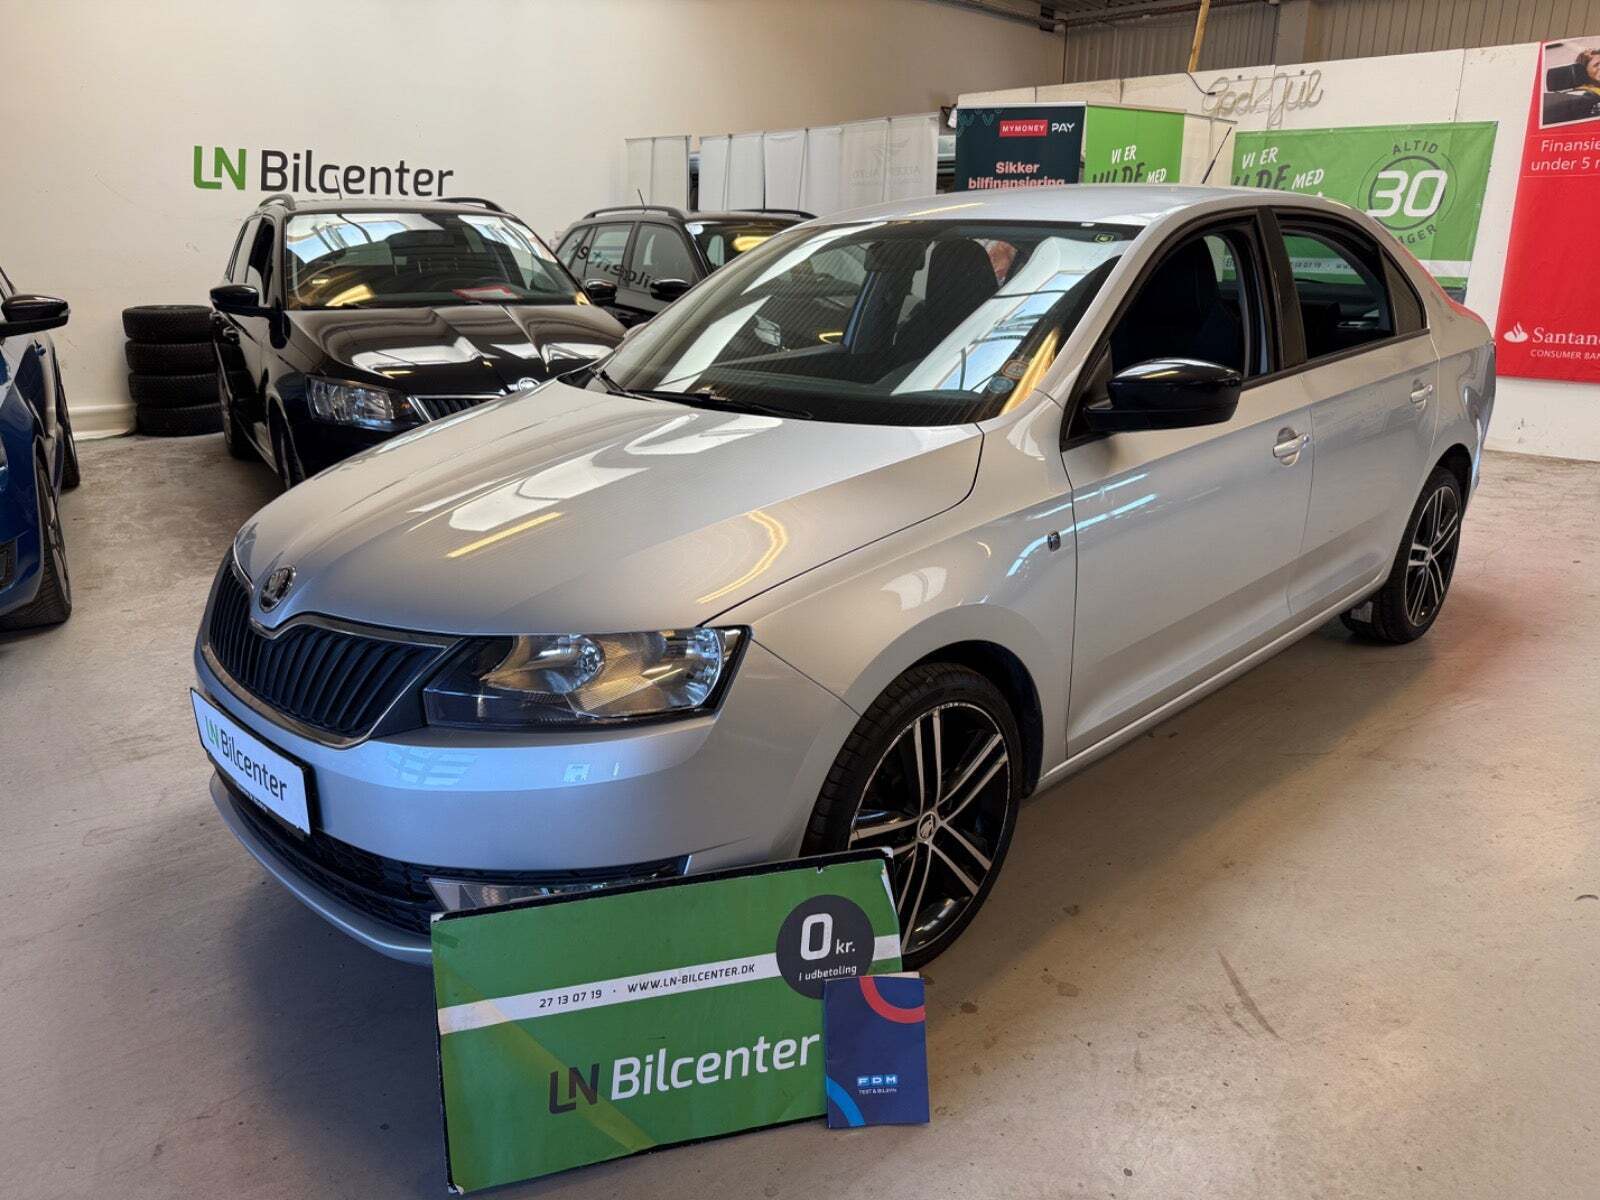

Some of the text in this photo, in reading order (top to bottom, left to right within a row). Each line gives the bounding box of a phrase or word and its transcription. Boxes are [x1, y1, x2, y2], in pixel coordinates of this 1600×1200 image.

[1002, 122, 1075, 133] MYMONEY PAY
[1111, 144, 1137, 164] VI ER
[1393, 140, 1438, 154] ALTID
[996, 161, 1040, 174] Sikker
[1242, 147, 1278, 170] VI ER
[1531, 157, 1577, 171] under
[1581, 157, 1591, 169] 5
[193, 145, 454, 197] LN Bilcenter
[1147, 167, 1167, 184] MED
[1292, 169, 1324, 190] MED
[1367, 170, 1448, 217] 30
[1532, 326, 1600, 345] Santan
[1530, 348, 1582, 360] CONSUMER
[221, 729, 287, 801] Bilcenter
[800, 912, 856, 961] 0 kr.
[805, 965, 857, 981] udbetaling
[539, 963, 755, 1009] 27 13 07 19 WWW.LN-BILCENTER.DK
[549, 1033, 820, 1115] LN Bilcenter
